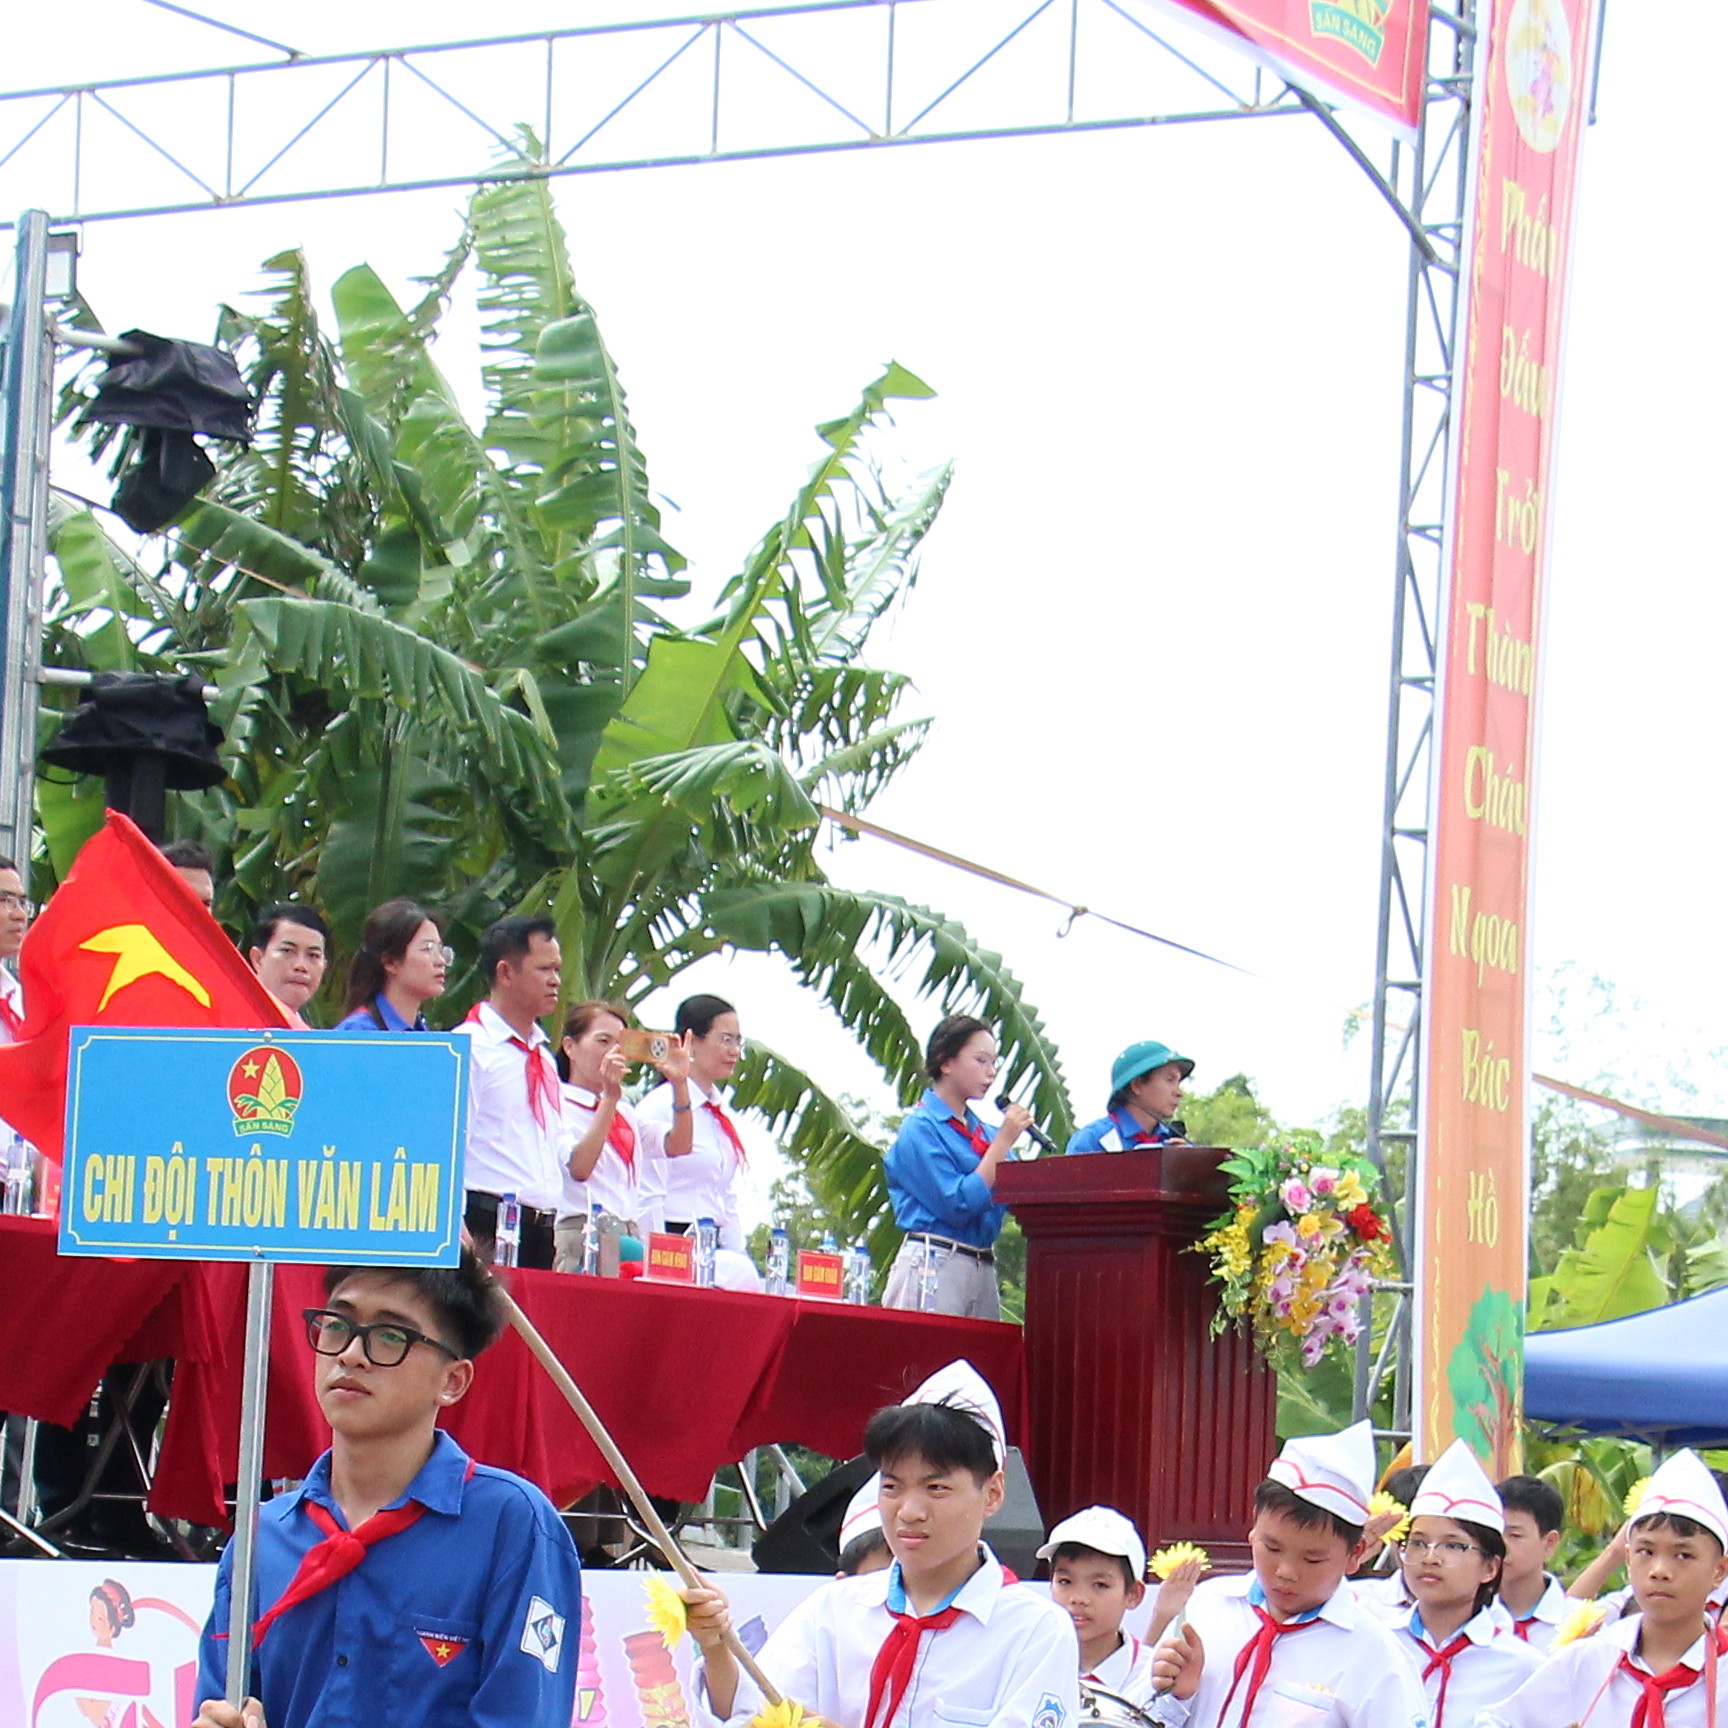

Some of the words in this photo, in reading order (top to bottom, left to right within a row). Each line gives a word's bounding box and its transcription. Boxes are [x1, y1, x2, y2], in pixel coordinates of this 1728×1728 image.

[1461, 1027, 1511, 1112] Bác
[83, 1153, 136, 1224] CHI
[142, 1141, 197, 1242] ĐỘI
[206, 1143, 289, 1229] THÔN
[298, 1145, 362, 1231] VĂN
[368, 1146, 441, 1233] LÂM
[1466, 1166, 1500, 1249] Hồ
